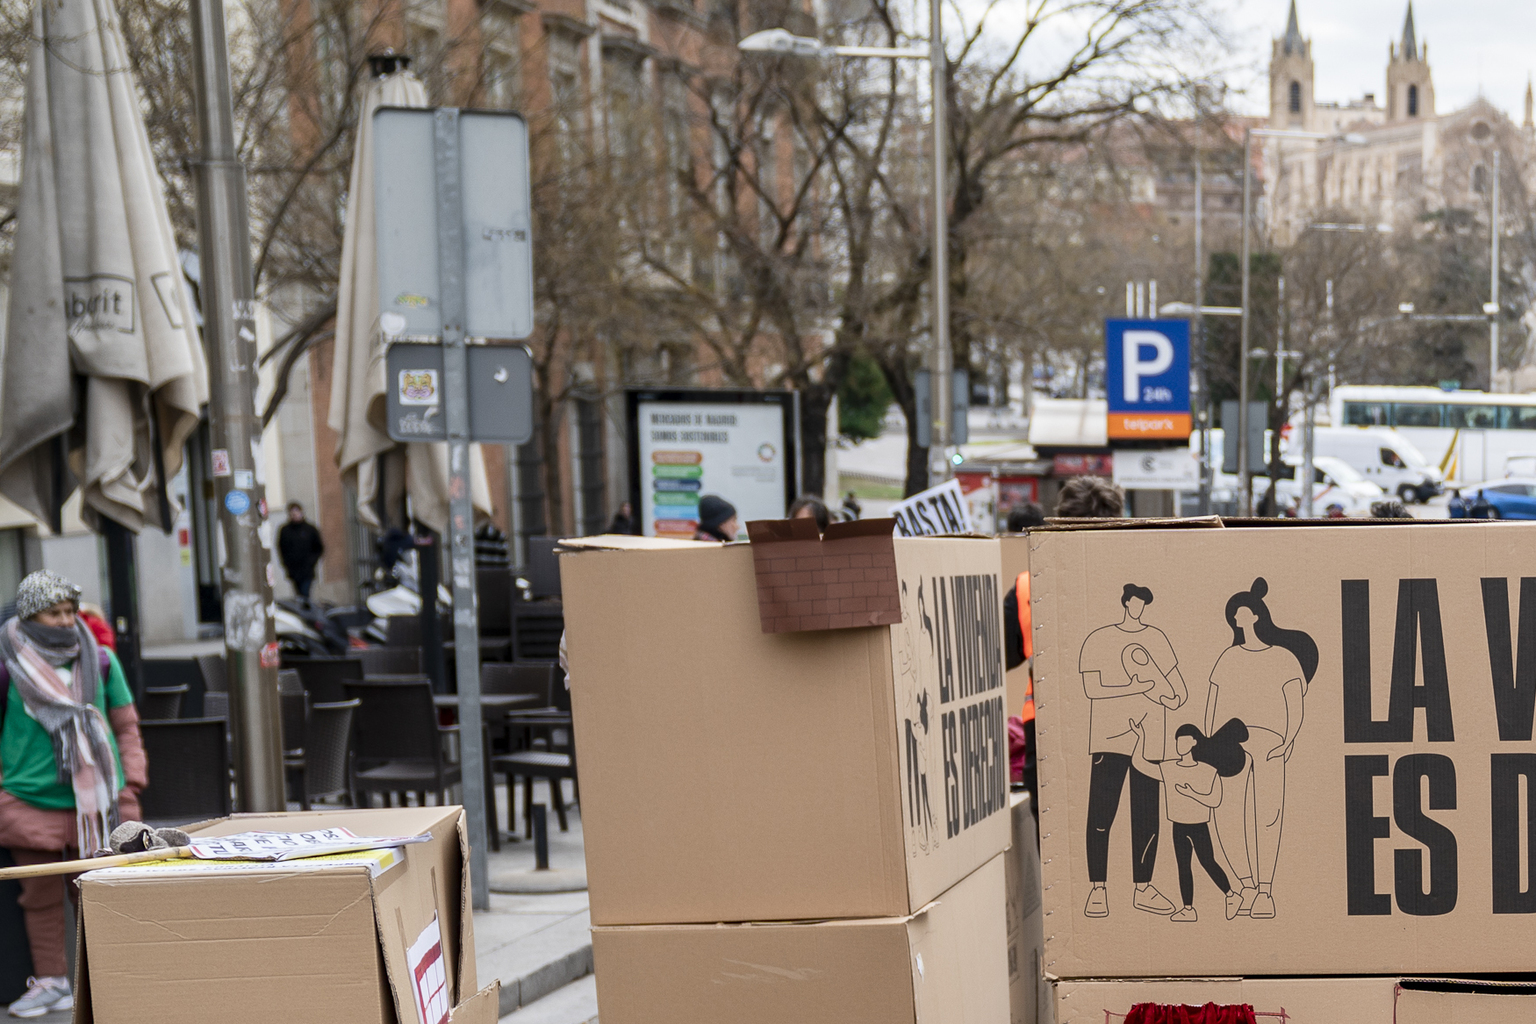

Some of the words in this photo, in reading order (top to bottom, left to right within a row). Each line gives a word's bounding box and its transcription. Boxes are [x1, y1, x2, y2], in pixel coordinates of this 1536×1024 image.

[1123, 330, 1174, 402] P
[1123, 418, 1174, 433] telpark
[932, 575, 955, 704] LA
[950, 573, 1003, 699] VIVIENDA
[1341, 578, 1455, 743] LA
[941, 710, 960, 840] ES
[959, 695, 1005, 830] DERECHO
[1344, 753, 1458, 916] ES
